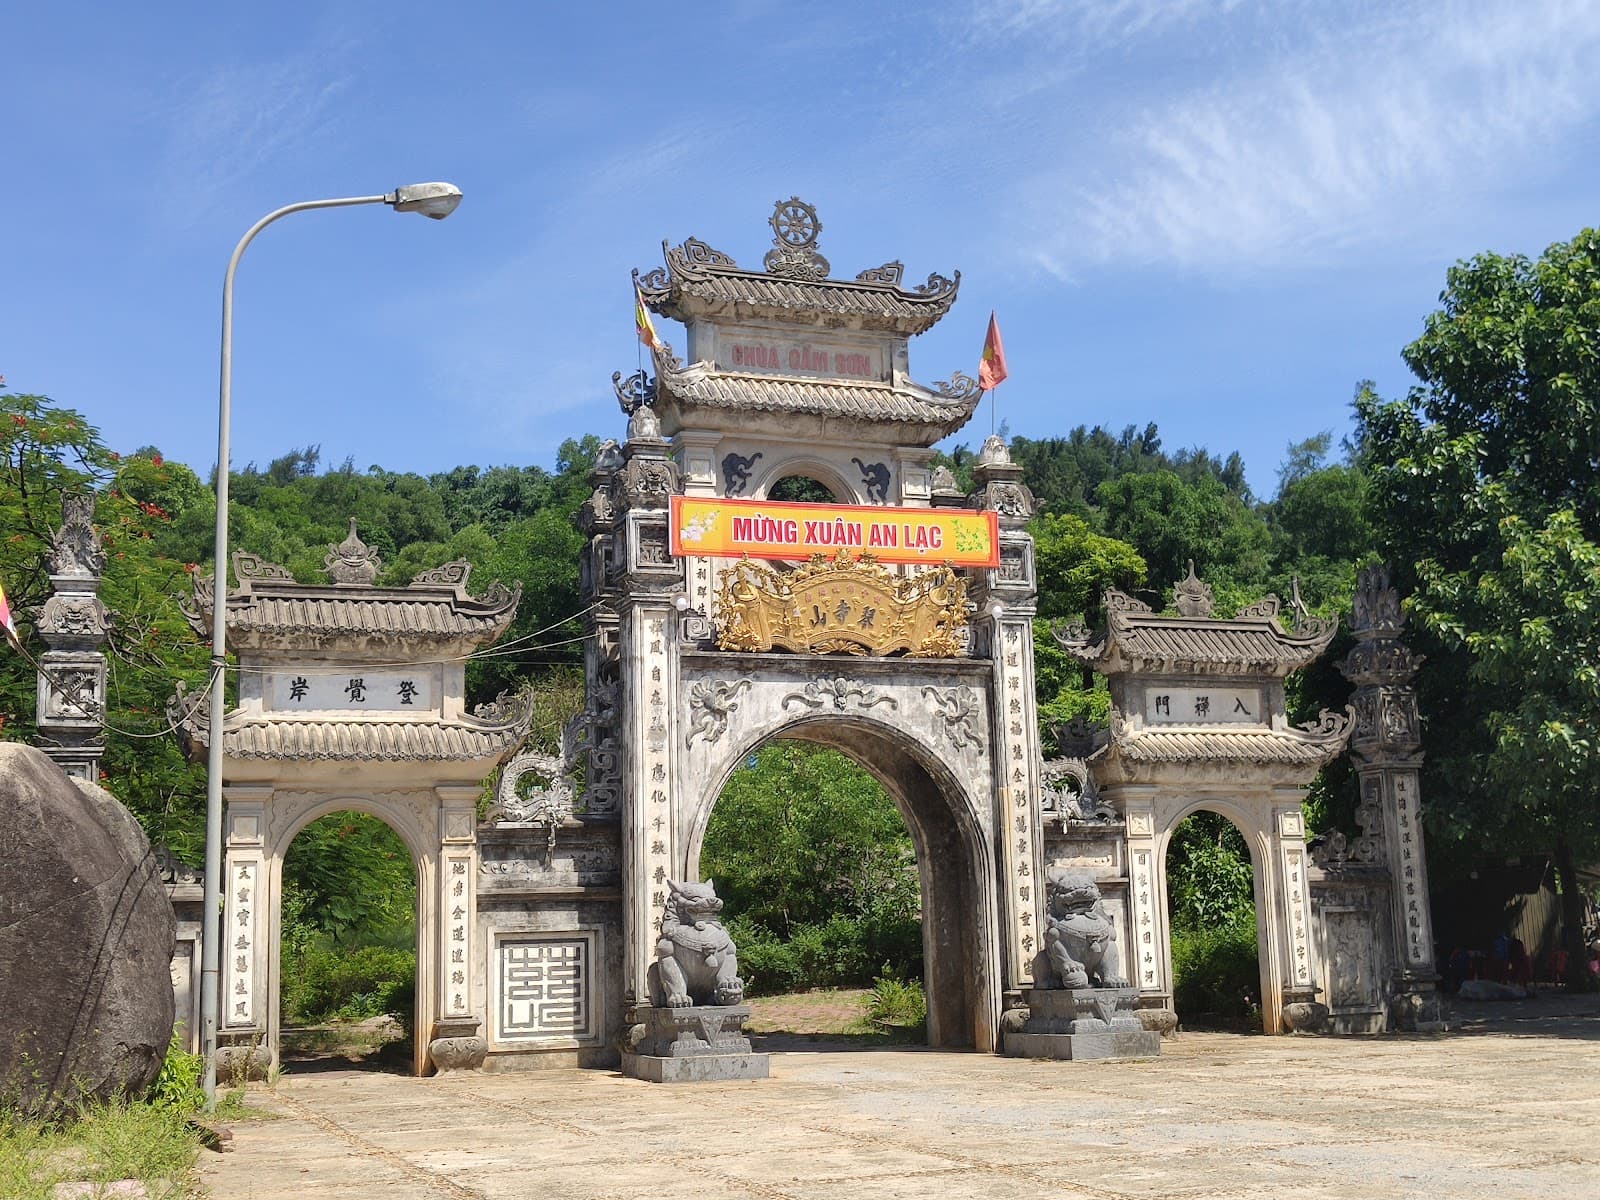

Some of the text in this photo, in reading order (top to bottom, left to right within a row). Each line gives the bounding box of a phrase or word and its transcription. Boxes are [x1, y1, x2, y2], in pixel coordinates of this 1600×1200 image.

[733, 515, 942, 554] MỪNG XUÂN AN LẠC
